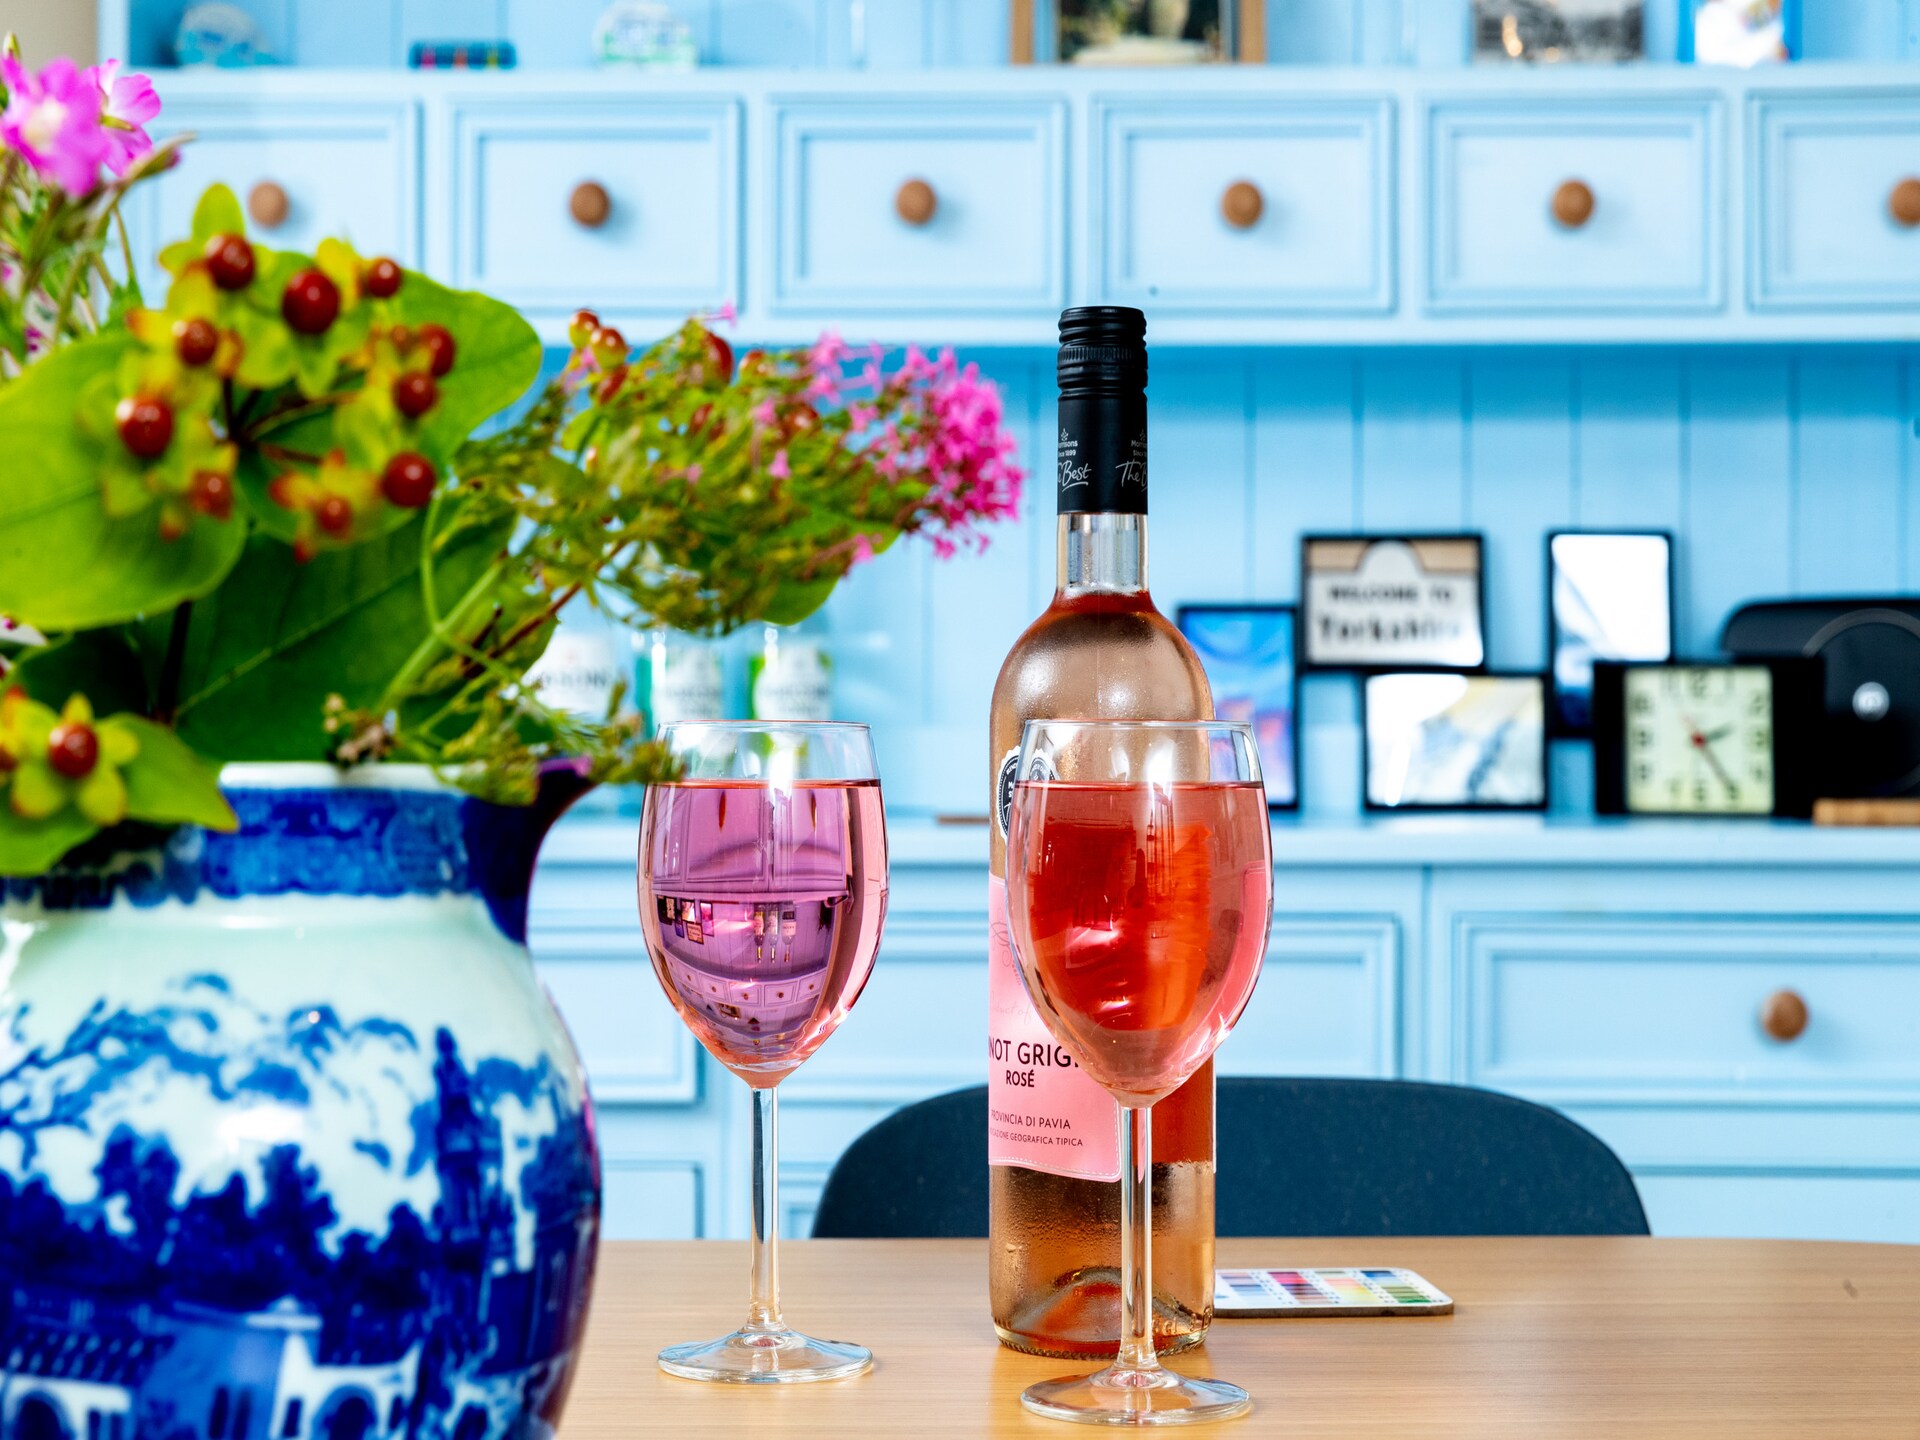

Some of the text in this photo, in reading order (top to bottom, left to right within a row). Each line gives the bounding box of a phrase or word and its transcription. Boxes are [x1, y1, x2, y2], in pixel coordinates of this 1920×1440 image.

[1062, 460, 1092, 487] Best
[989, 1036, 1079, 1068] NOT GRIG
[1006, 1069, 1035, 1088] ROSÉ
[1025, 1116, 1036, 1127] DI
[1039, 1117, 1071, 1130] PAVIA
[1010, 1132, 1053, 1145] GEOGRAFICA
[1056, 1137, 1083, 1147] TIPICA
